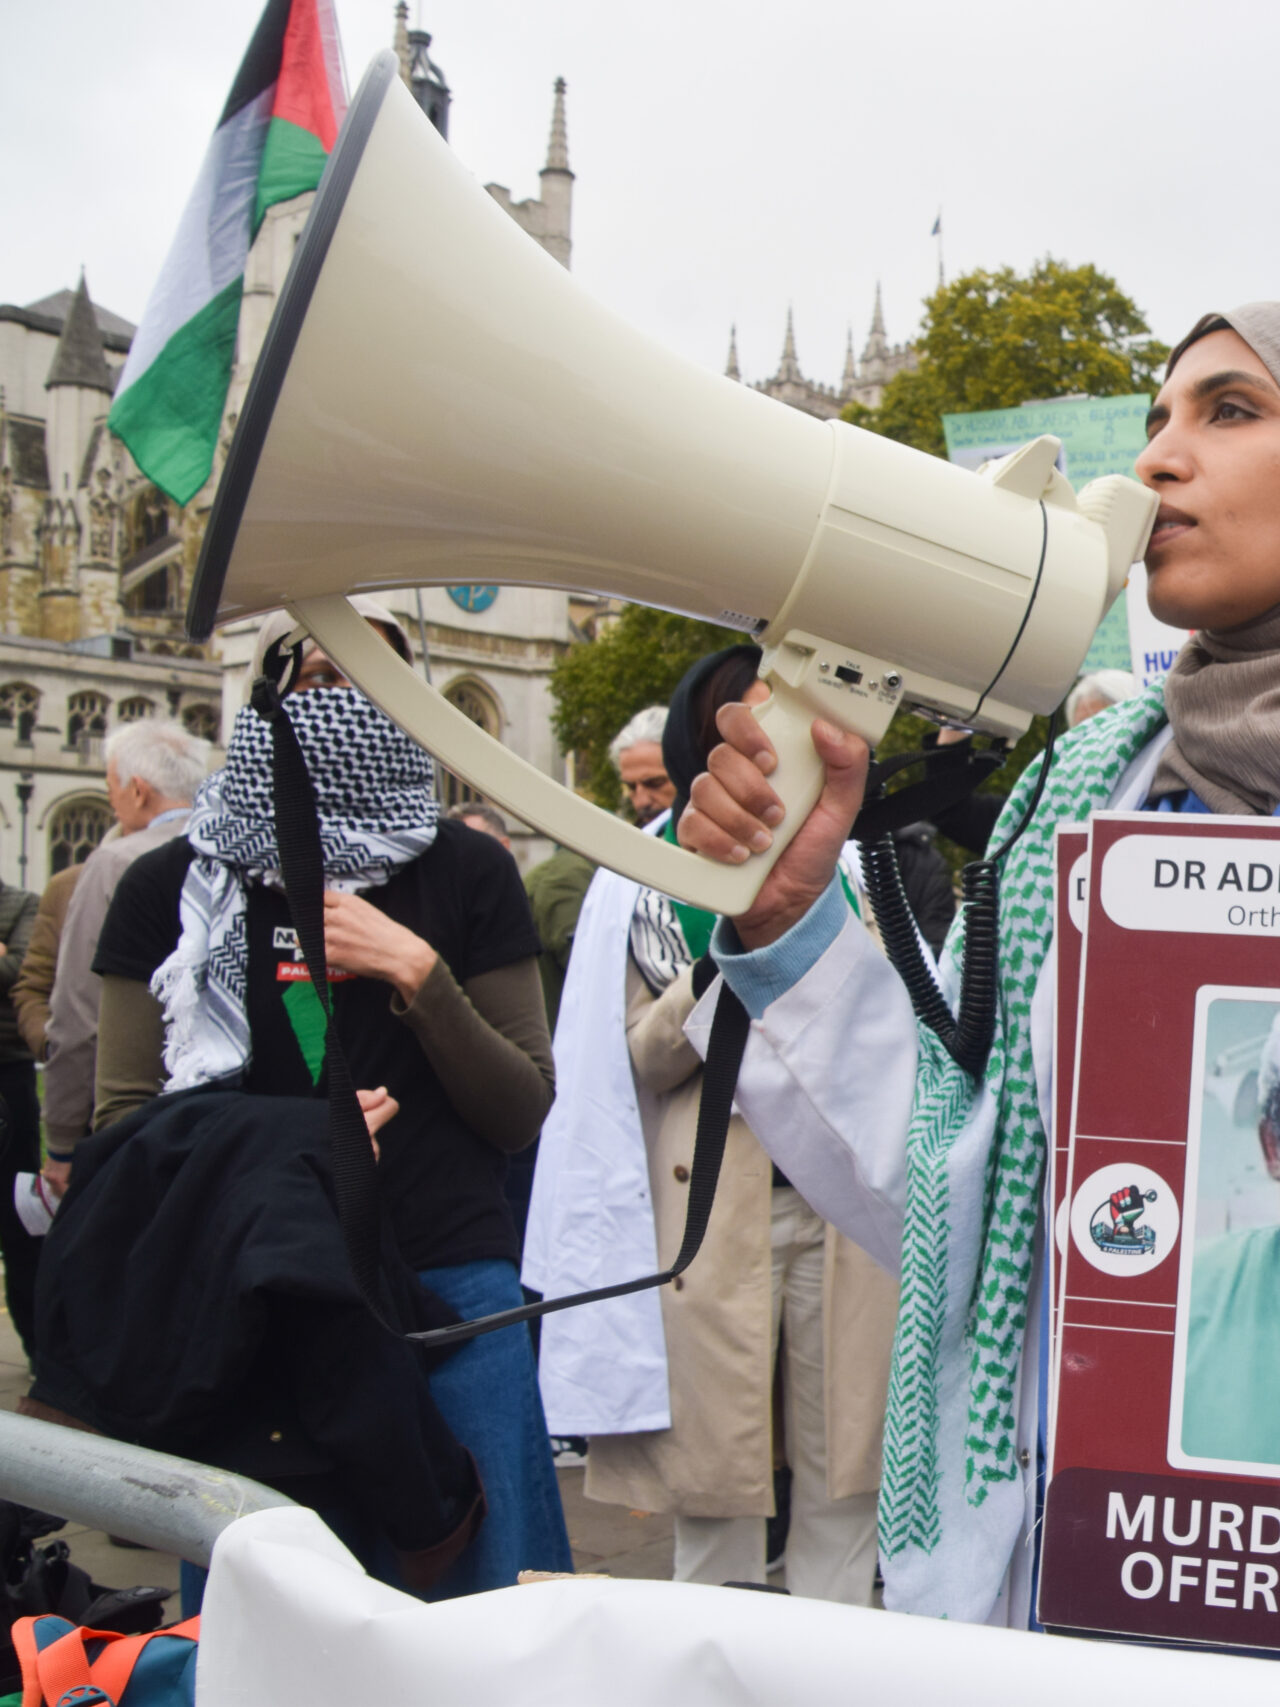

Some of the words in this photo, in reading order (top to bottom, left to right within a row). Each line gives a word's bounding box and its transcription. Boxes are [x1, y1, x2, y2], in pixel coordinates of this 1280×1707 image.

[1144, 650, 1179, 673] HU
[1154, 859, 1207, 890] DR
[1121, 1551, 1279, 1612] OFER
